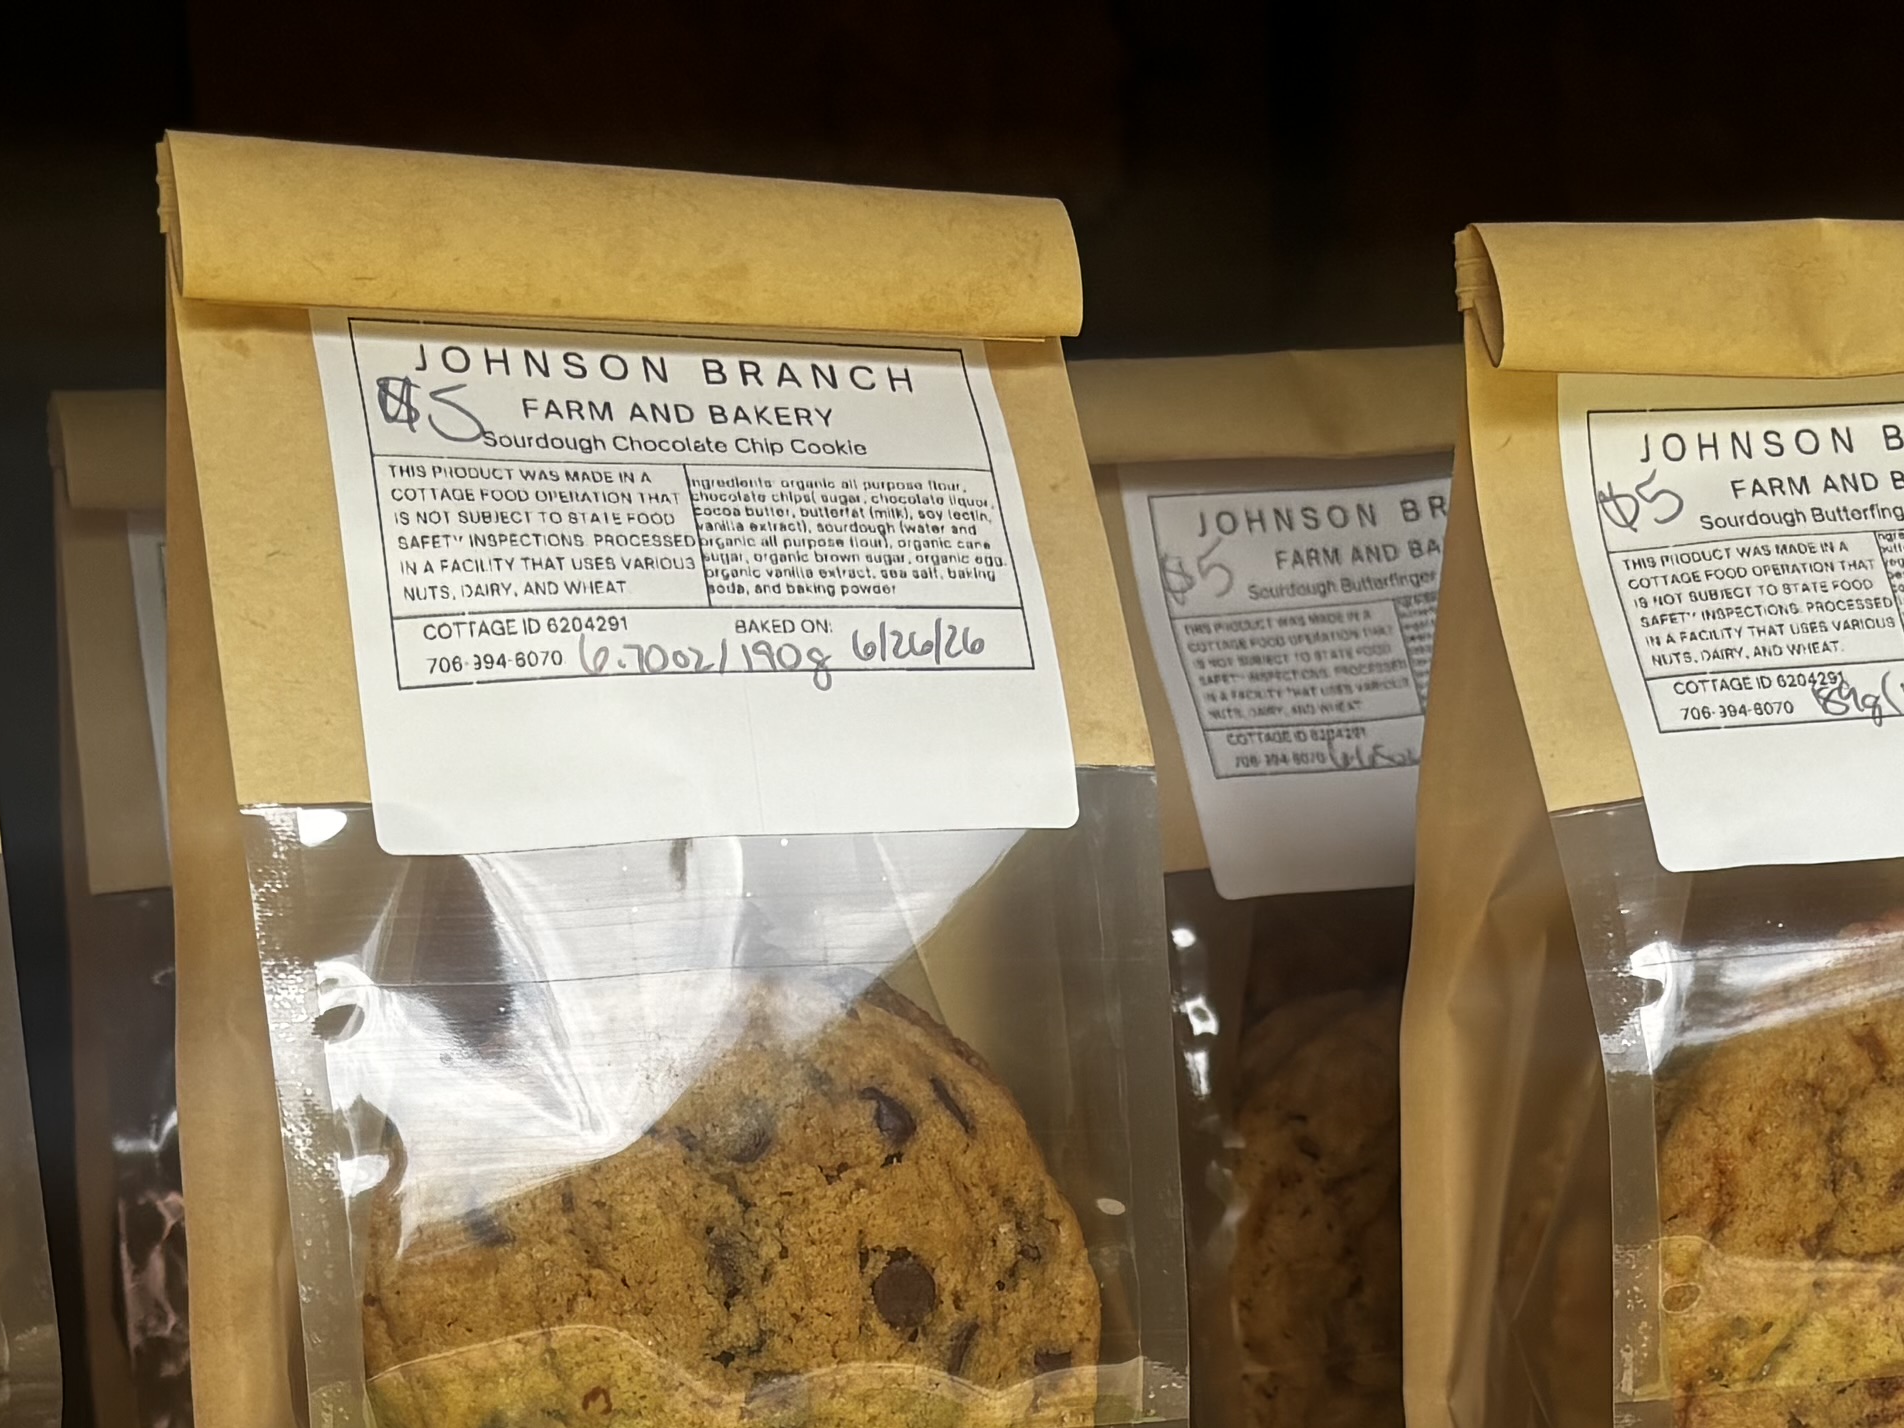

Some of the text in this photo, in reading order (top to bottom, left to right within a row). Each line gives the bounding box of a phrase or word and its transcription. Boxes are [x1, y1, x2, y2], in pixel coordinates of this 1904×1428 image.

[413, 342, 914, 395] JOHNSON BRANCH
[520, 397, 833, 429] FARM AND BAKERY
[481, 427, 868, 458] Sourdough Chocolate Chip Cookie
[1639, 425, 1855, 464] JOHNSON
[1729, 474, 1812, 501] FARM
[1822, 471, 1880, 495] AND
[1197, 502, 1378, 538] JOHNSON
[1698, 507, 1808, 531] Sourdough
[1275, 547, 1343, 571] FARM
[1350, 543, 1398, 564] AND
[733, 618, 834, 635] BAKED ON:
